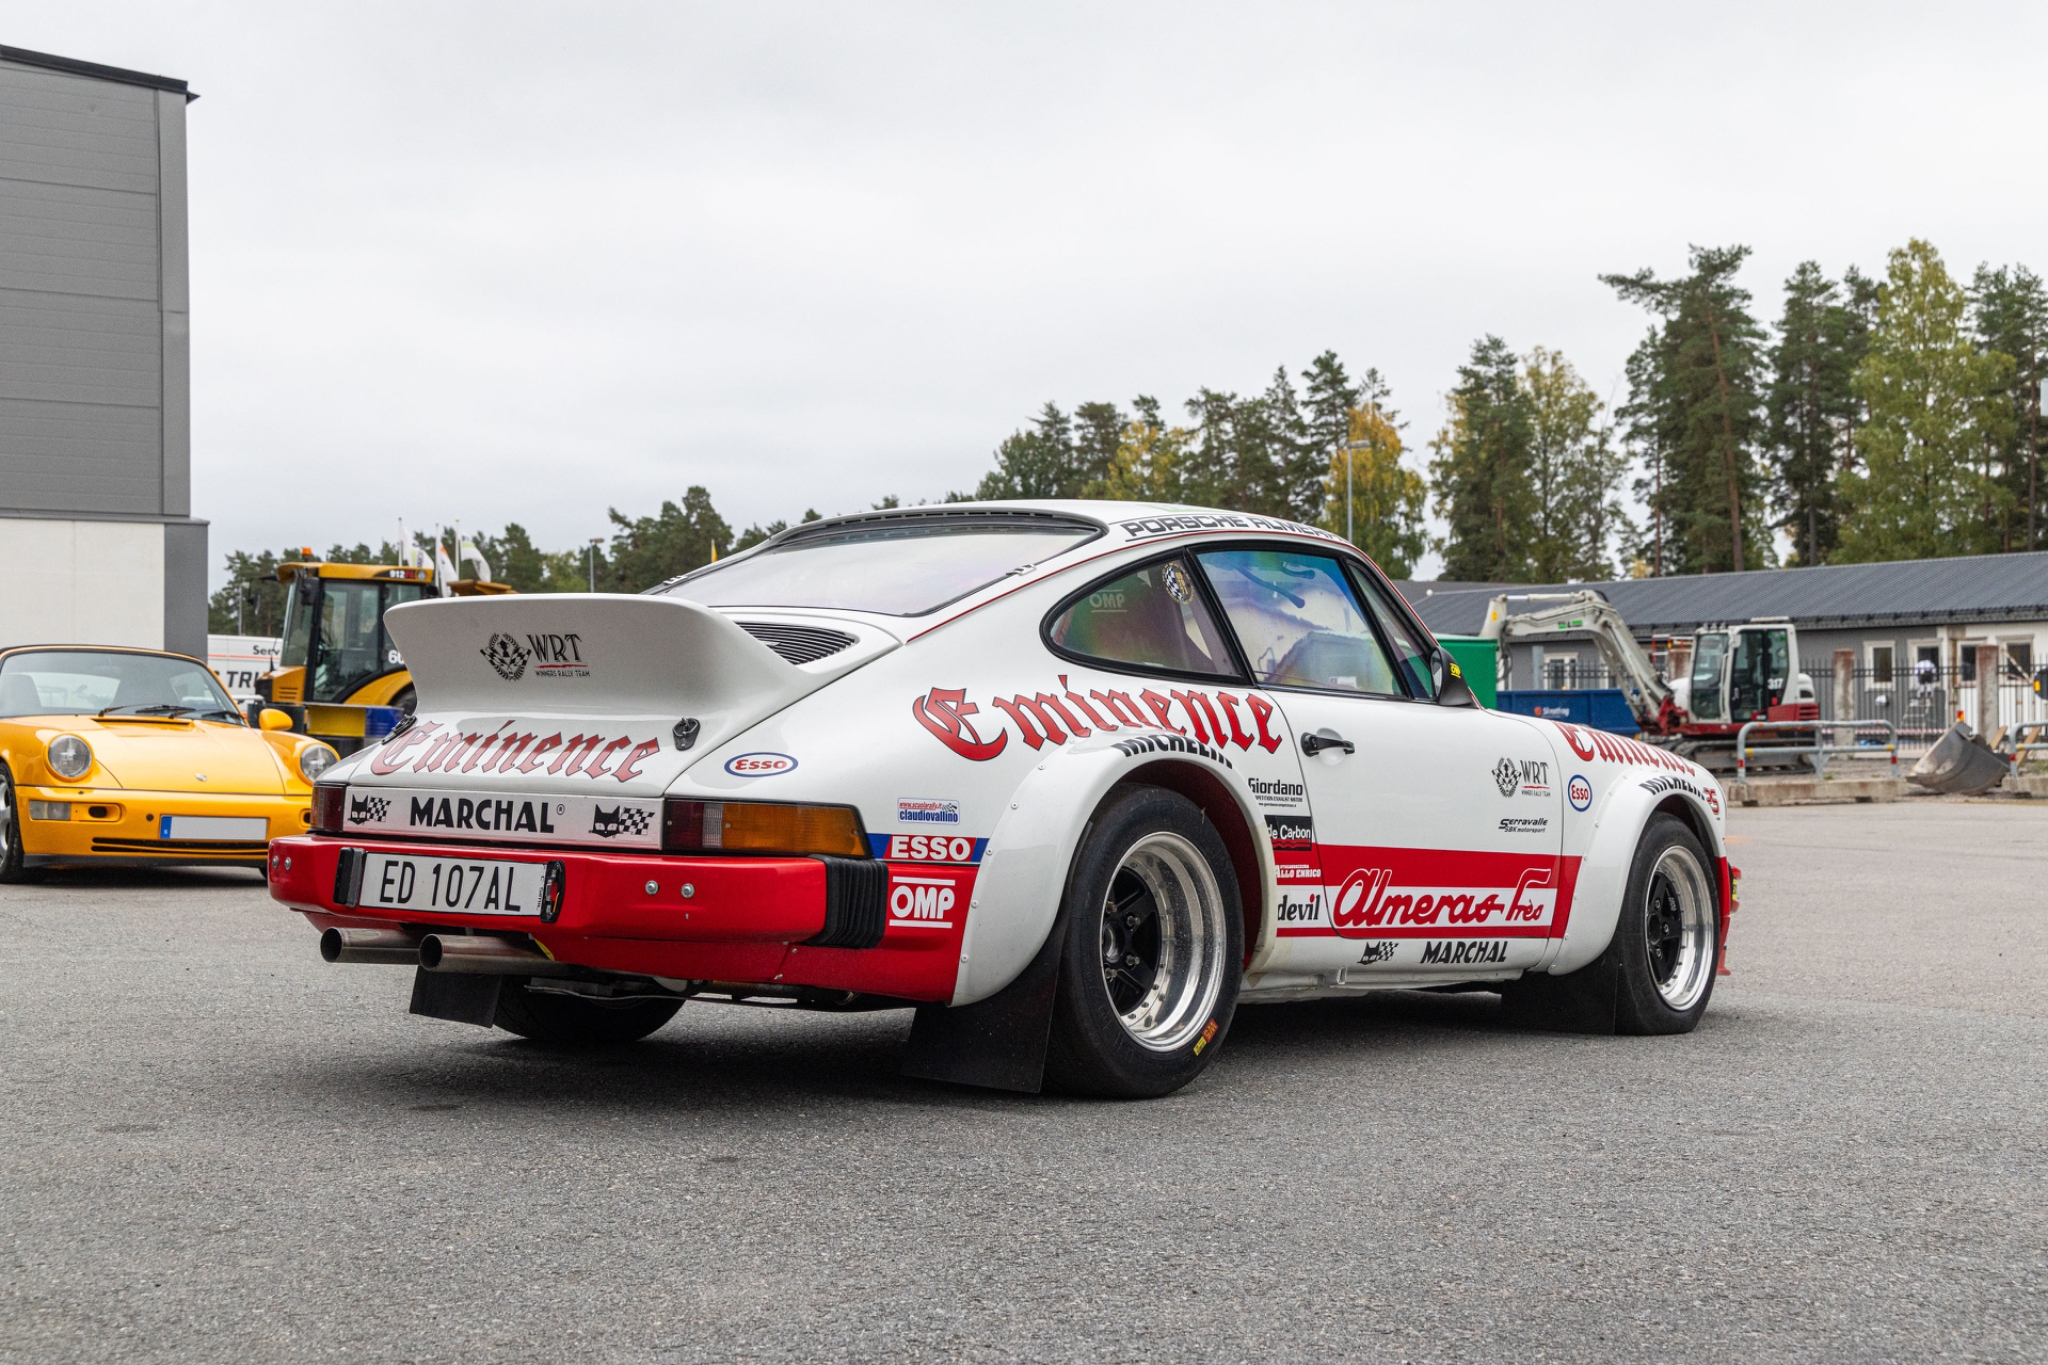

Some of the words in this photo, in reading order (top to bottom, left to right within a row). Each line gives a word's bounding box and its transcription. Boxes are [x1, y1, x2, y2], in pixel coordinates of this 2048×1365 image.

[1120, 515, 1248, 537] PORSCHE
[1089, 593, 1125, 608] OMP
[526, 633, 582, 662] WRT
[1767, 678, 1783, 690] 317
[912, 674, 1283, 762] Eminence
[371, 720, 660, 783] Eminence
[1111, 734, 1233, 770] MICHELIN
[1520, 760, 1549, 785] WRT
[1248, 778, 1303, 796] Giordano
[1639, 775, 1706, 801] MICHELIN
[410, 796, 555, 834] MARCHAL
[899, 810, 958, 823] claudiovallino
[1498, 818, 1549, 830] Serravalle
[1280, 825, 1311, 841] Carbon
[891, 836, 971, 861] ESSO
[379, 860, 416, 904] ED
[431, 863, 521, 911] 107AL
[890, 886, 955, 919] OMP
[1277, 893, 1321, 921] devil
[1420, 941, 1508, 964] MARCHAL
